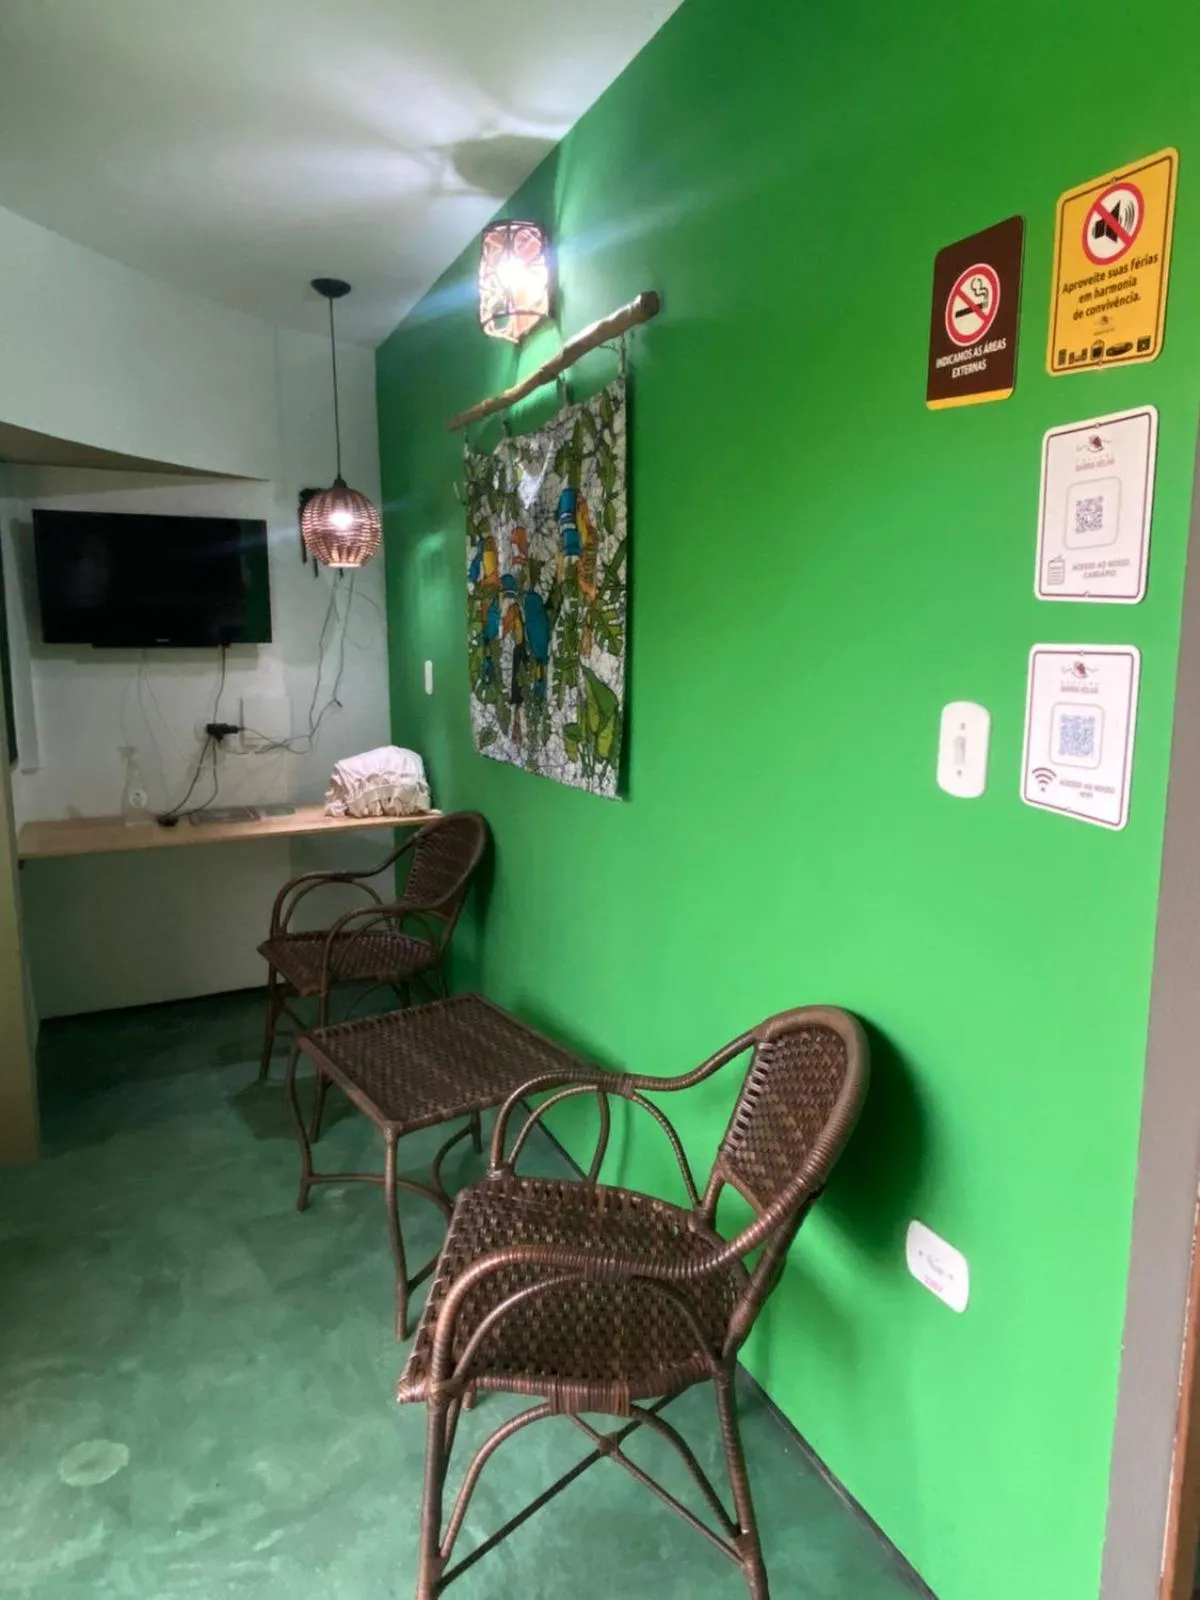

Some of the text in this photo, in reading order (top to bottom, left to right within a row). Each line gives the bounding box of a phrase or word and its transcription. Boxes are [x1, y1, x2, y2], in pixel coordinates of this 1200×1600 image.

[1062, 253, 1159, 294] Aproveite suas férias
[1078, 277, 1138, 303] em harmonia
[1072, 292, 1142, 321] de convivência.
[936, 348, 973, 369] INDICAMOS
[973, 345, 982, 357] AS
[952, 359, 987, 378] EXTERNAS
